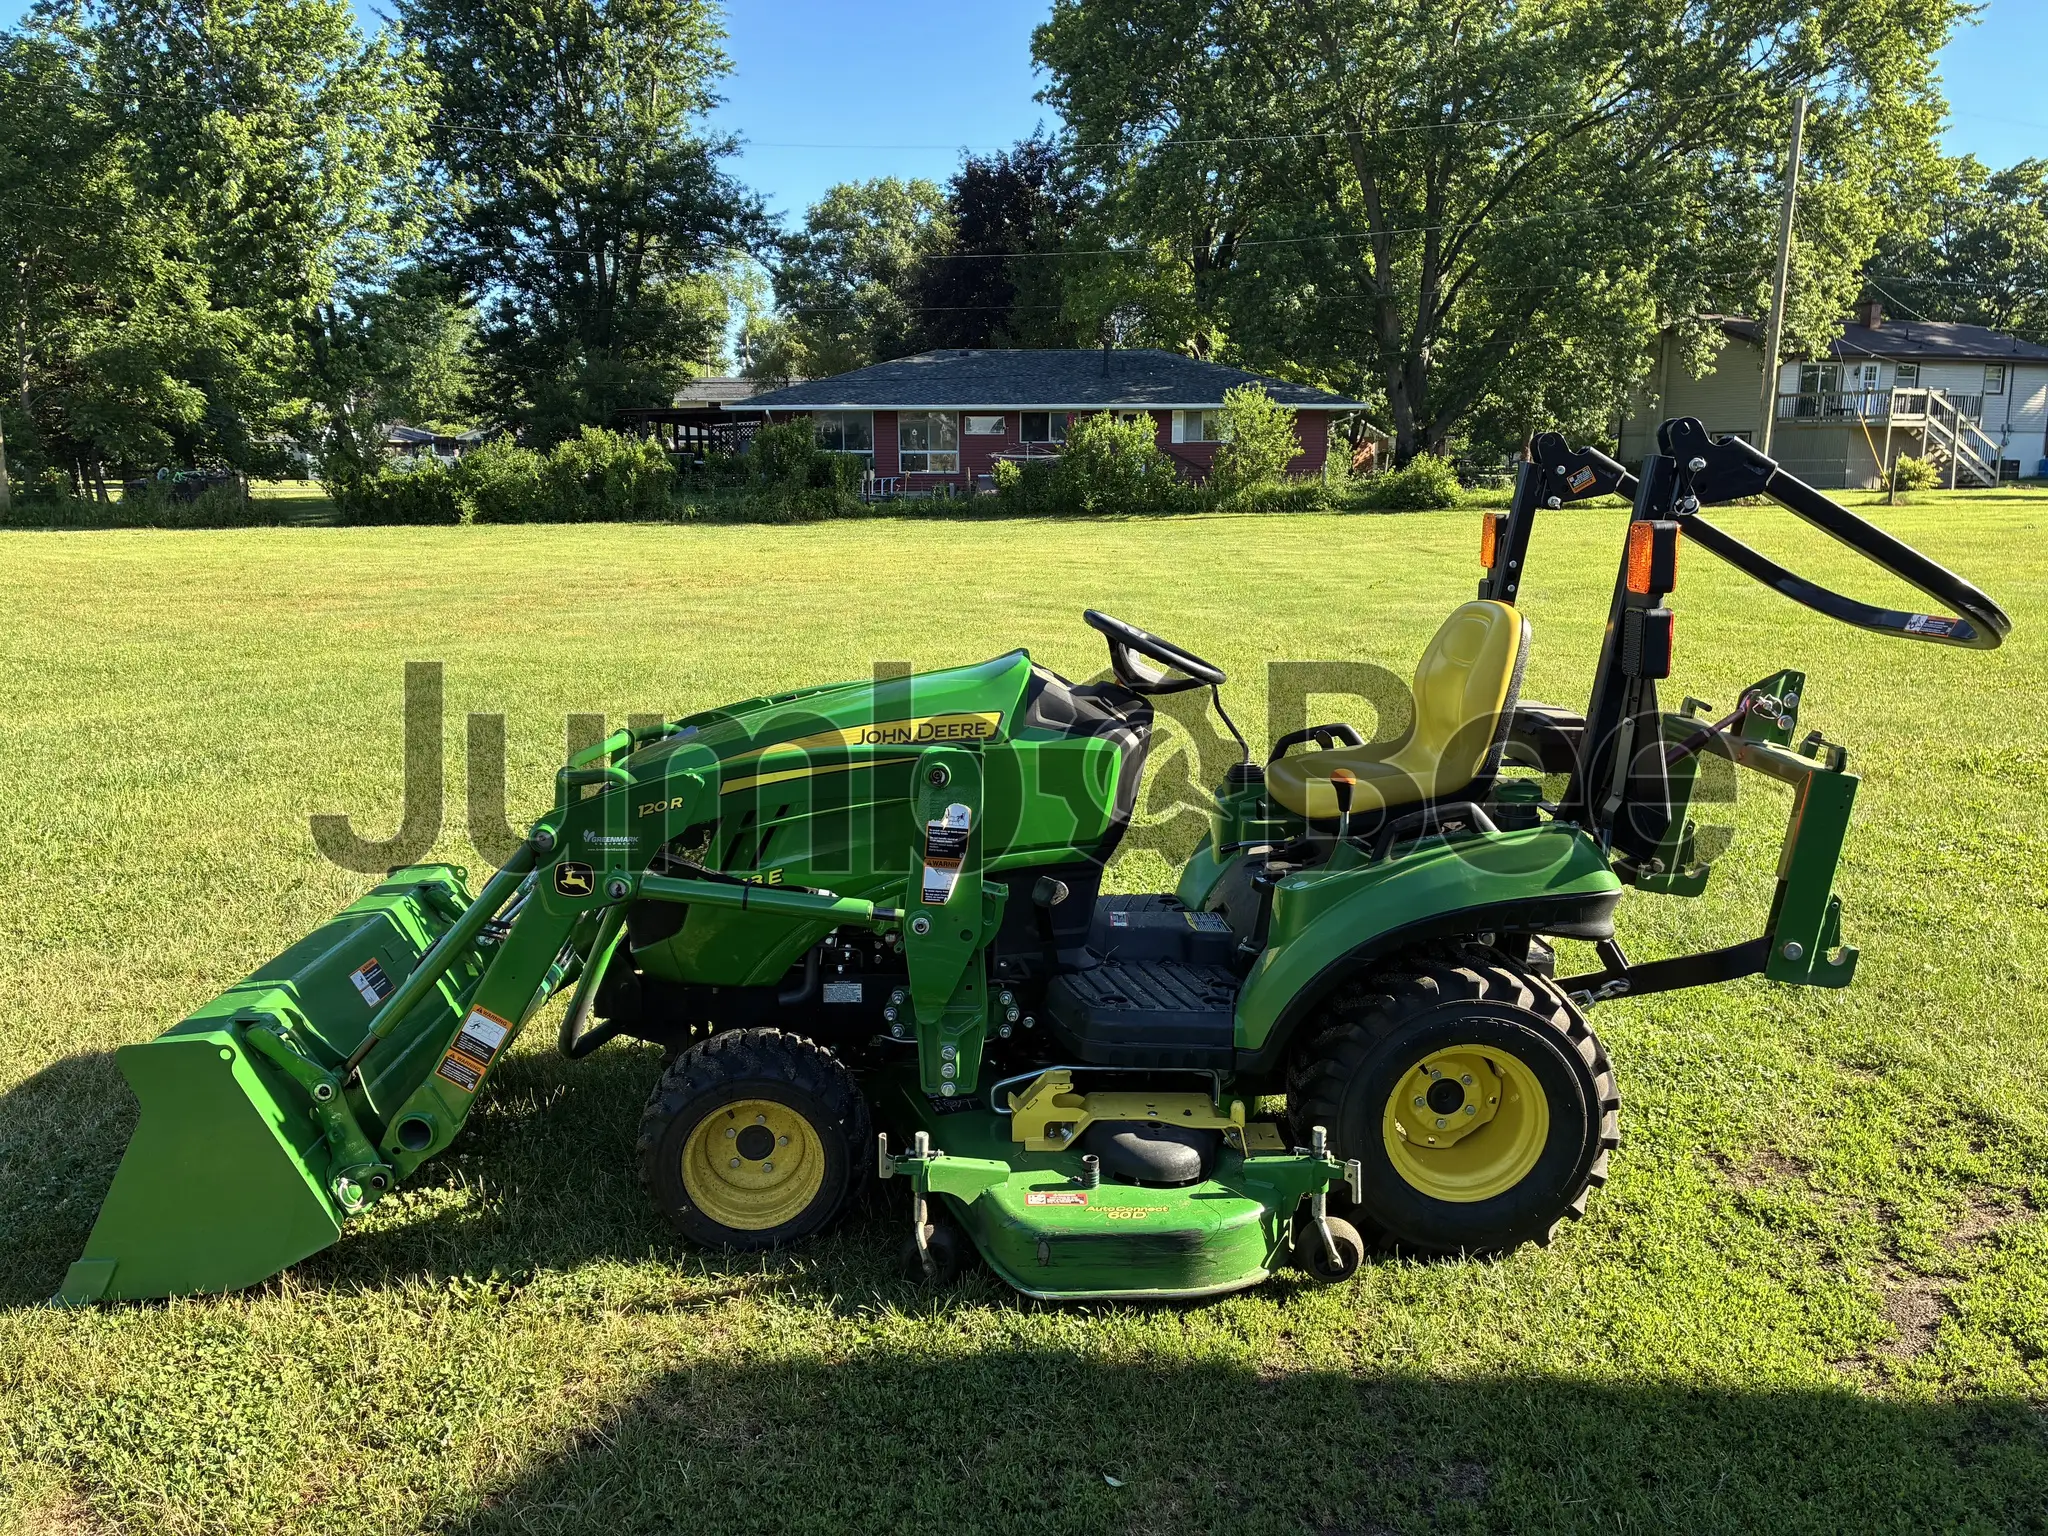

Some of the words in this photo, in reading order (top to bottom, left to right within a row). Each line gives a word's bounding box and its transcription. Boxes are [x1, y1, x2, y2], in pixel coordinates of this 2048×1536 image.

[853, 727, 912, 745] JOHN
[917, 722, 987, 740] DEERE
[932, 859, 961, 869] WARNIN
[482, 1010, 508, 1027] WARNING
[456, 1056, 481, 1072] WARNING
[1107, 1211, 1148, 1219] 60D
